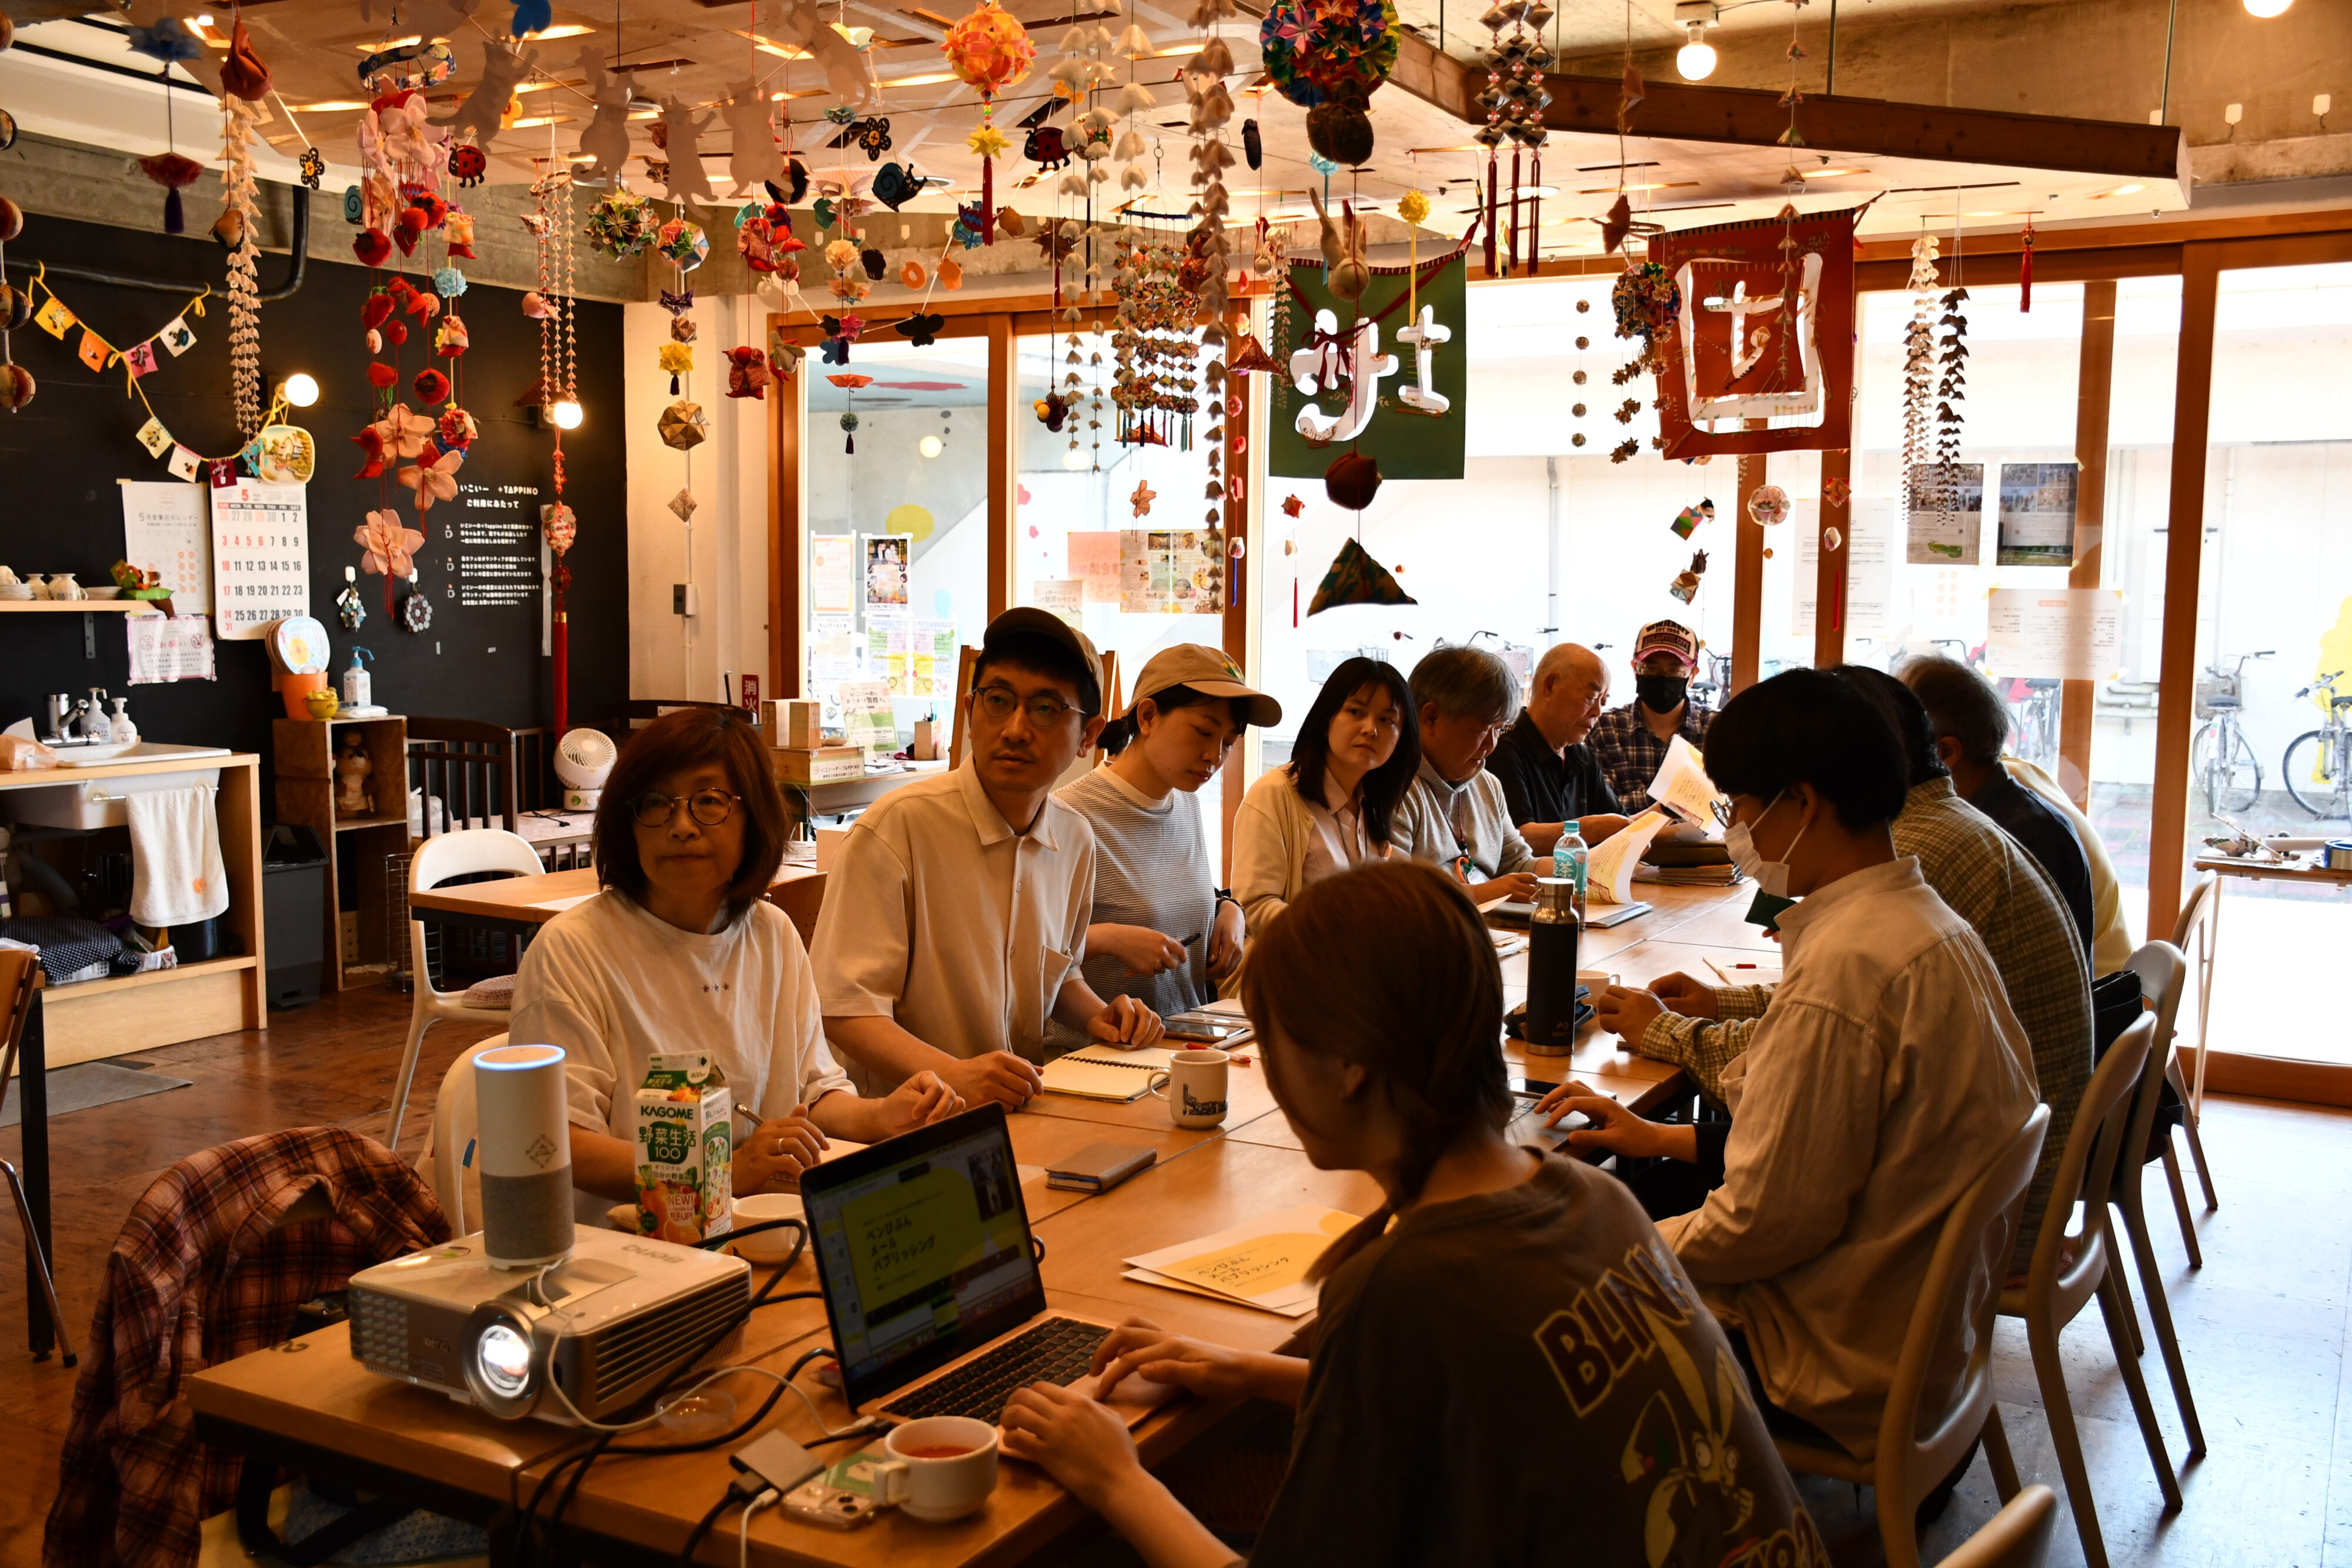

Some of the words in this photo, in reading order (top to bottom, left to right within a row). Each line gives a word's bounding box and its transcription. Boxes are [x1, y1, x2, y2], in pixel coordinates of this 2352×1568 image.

[242, 489, 249, 501] 5
[467, 499, 519, 509] ご利用にあたって
[232, 511, 240, 521] 27
[243, 511, 252, 521] 28
[267, 512, 276, 521] 30
[282, 513, 286, 522] 1
[293, 513, 298, 522] 2
[222, 536, 227, 546] 3
[235, 536, 239, 546] 4
[246, 536, 251, 546] 5
[258, 536, 263, 546] 6
[270, 537, 275, 546] 7
[282, 537, 286, 546] 8
[294, 537, 299, 547] 9
[222, 560, 230, 571] 10
[234, 561, 241, 571] 11
[246, 561, 253, 571] 12
[258, 561, 266, 571] 13
[270, 561, 278, 571] 14
[282, 561, 289, 571] 15
[293, 561, 301, 571] 16
[223, 586, 230, 596] 17
[235, 586, 243, 596] 18
[247, 586, 255, 596] 19
[258, 586, 267, 596] 20
[270, 586, 279, 596] 21
[282, 586, 290, 596] 22
[293, 585, 302, 595] 23
[224, 610, 231, 618] 24
[235, 610, 245, 621] 25
[247, 610, 256, 621] 26
[259, 610, 268, 621] 27
[270, 610, 279, 620] 28
[226, 623, 232, 631] 31
[641, 1105, 693, 1119] KAGOME
[639, 1126, 696, 1147] 野菜生活
[656, 1146, 681, 1159] 100
[668, 1195, 694, 1205] NEW!
